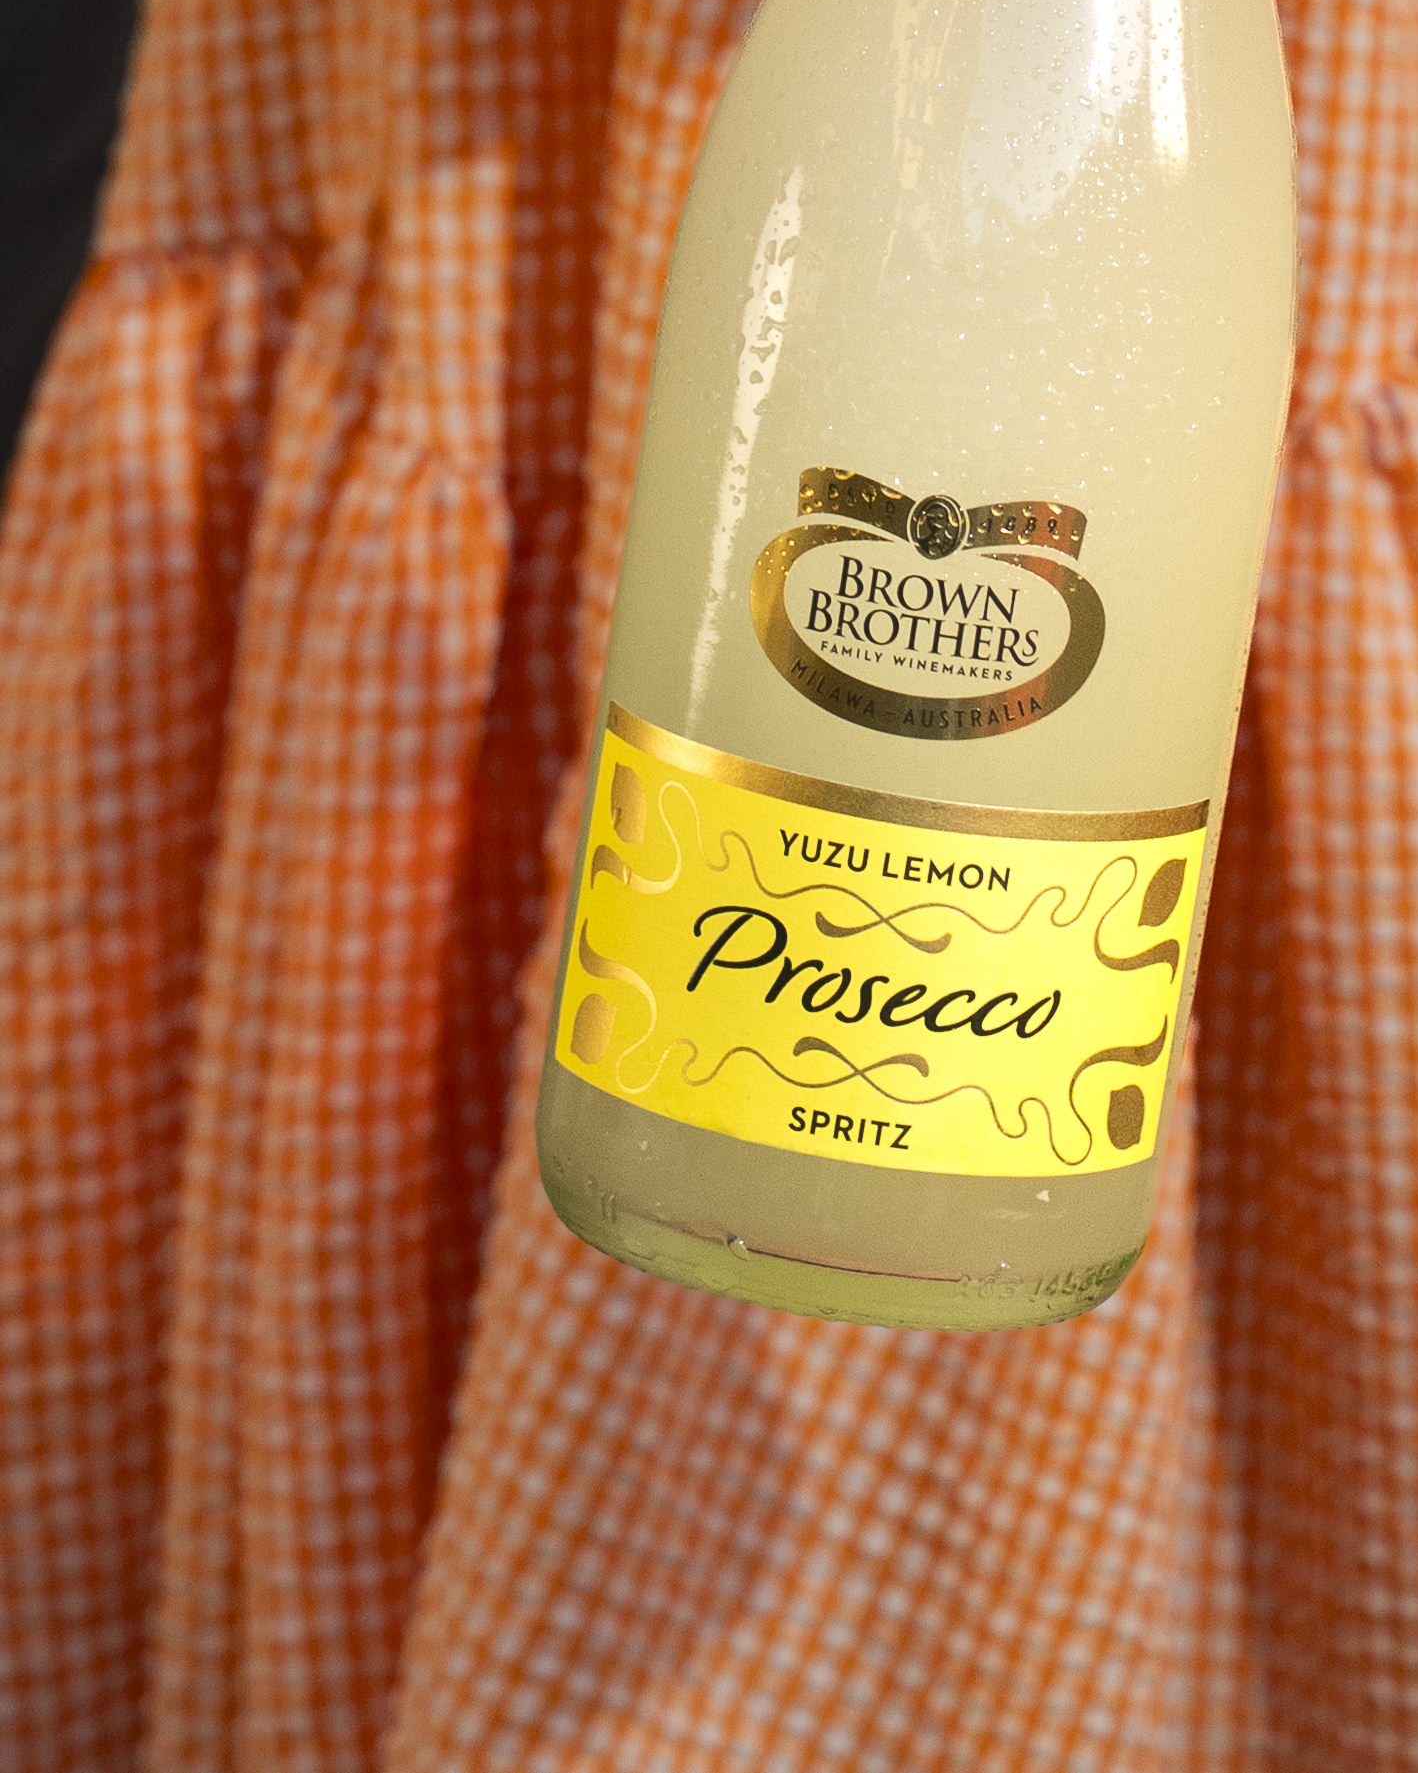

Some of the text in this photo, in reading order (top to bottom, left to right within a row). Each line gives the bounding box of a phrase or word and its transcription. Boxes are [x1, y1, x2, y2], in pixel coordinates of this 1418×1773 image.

[836, 554, 1020, 624] BROWN
[805, 587, 1039, 667] BROTHERS
[820, 641, 1013, 681] FAMILY WINEMAKERS
[791, 658, 1043, 729] MILAWA AUSTRALIA
[779, 829, 1012, 892] YUZU LEMON
[686, 905, 1062, 1039] Prosecco
[788, 1106, 912, 1150] SPRITZ
